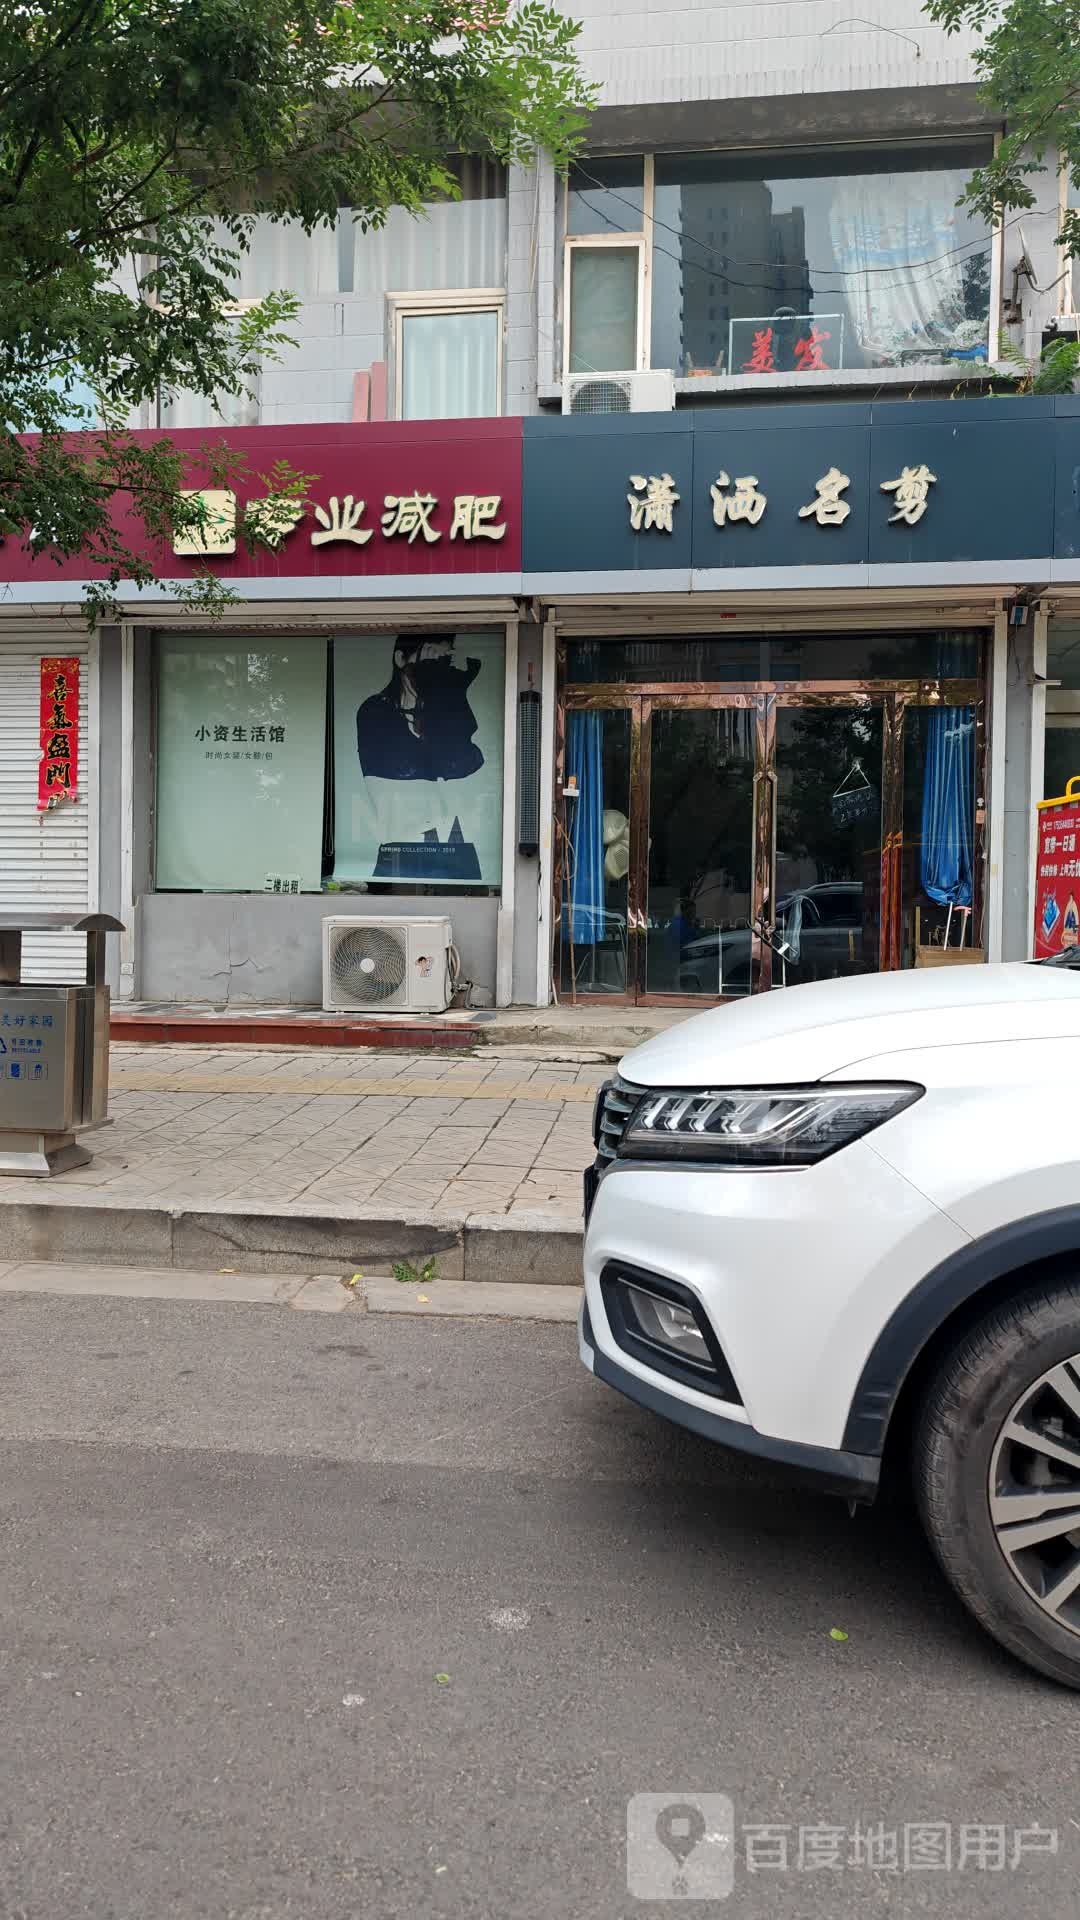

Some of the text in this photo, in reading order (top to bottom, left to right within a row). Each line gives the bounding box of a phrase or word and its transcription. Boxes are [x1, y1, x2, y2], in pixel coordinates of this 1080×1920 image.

[627, 465, 937, 533] 潇洒名剪
[195, 724, 285, 743] 小资生活馆
[264, 879, 299, 893] 二楼出租
